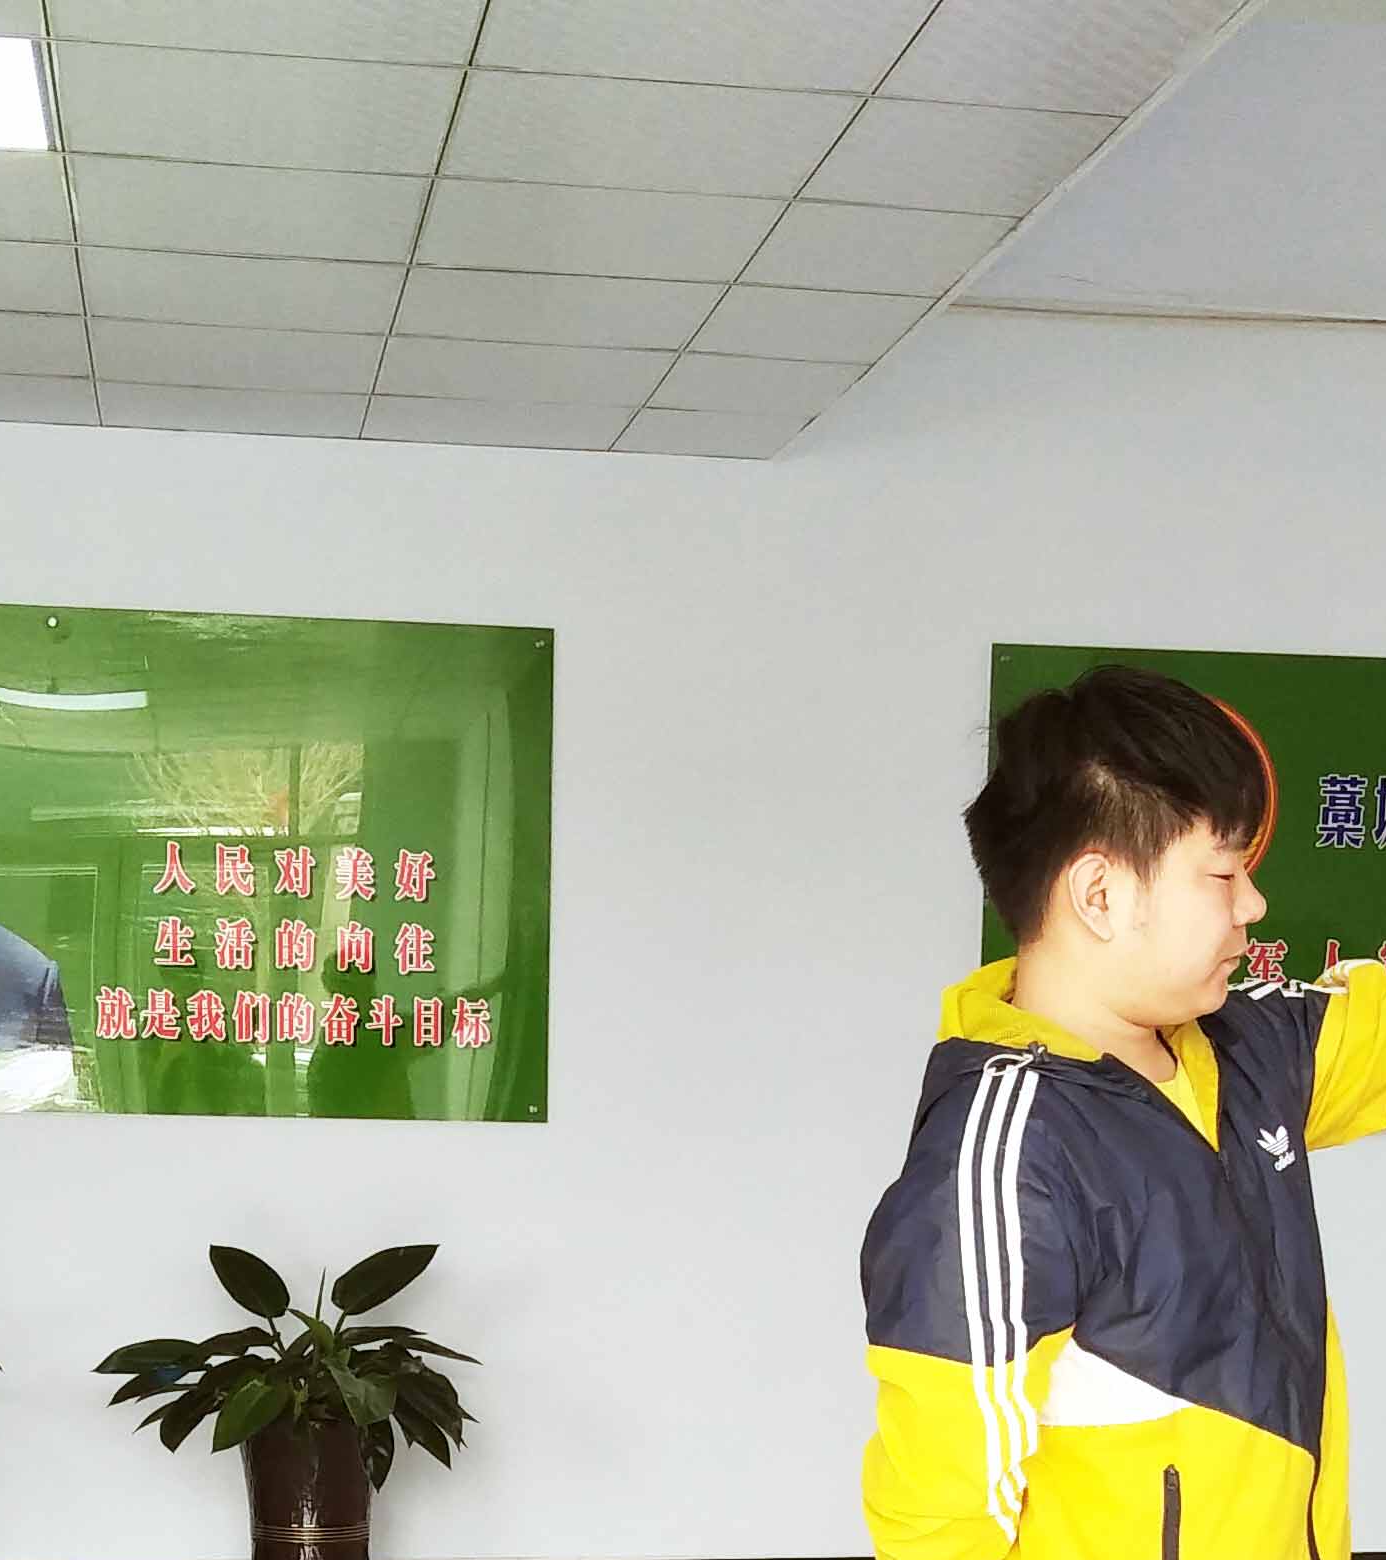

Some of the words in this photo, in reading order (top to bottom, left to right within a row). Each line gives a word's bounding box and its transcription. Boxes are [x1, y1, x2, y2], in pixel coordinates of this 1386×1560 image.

[154, 841, 436, 902] 人民对美好
[155, 917, 436, 975] 生活的向往
[96, 988, 493, 1048] 就是我们的奋斗目标
